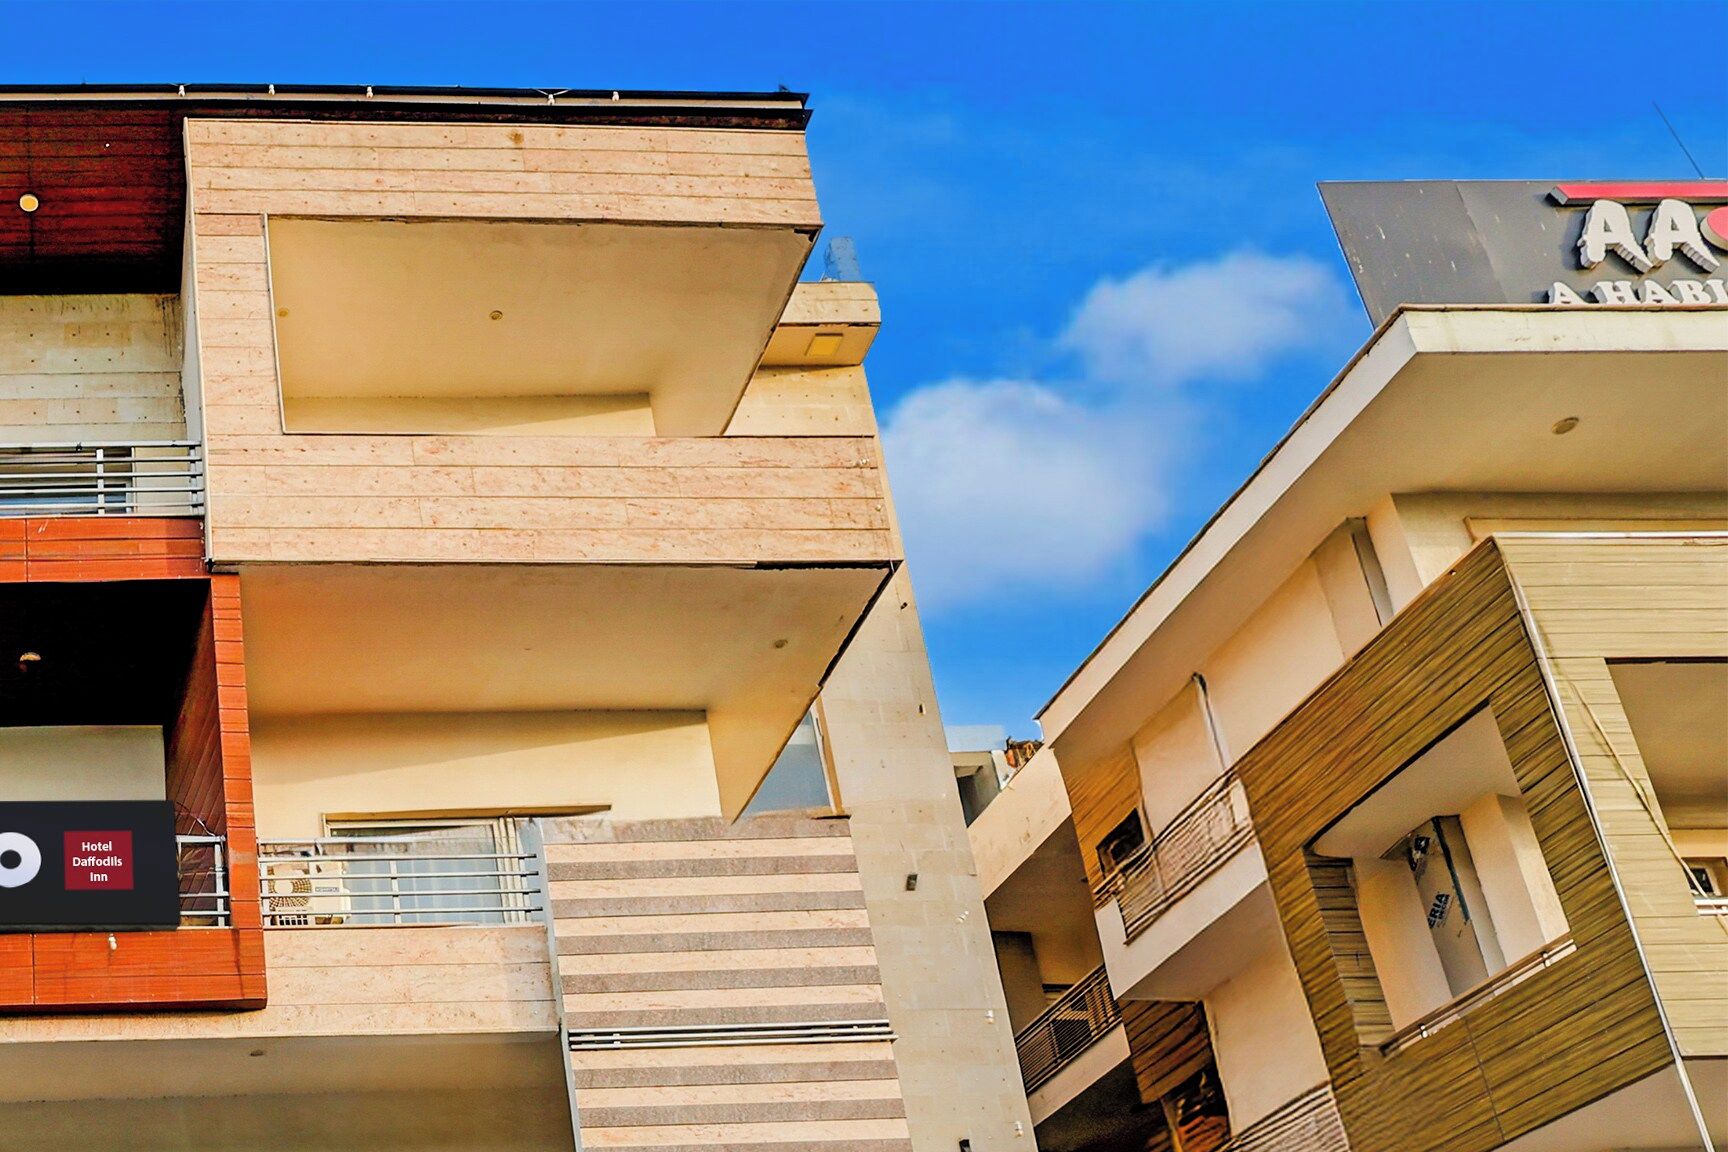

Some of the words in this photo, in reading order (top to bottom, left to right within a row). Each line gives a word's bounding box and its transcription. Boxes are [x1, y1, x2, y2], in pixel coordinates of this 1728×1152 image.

[81, 840, 113, 852] Hotel
[72, 856, 123, 867] Daffodils
[90, 871, 108, 882] Inn
